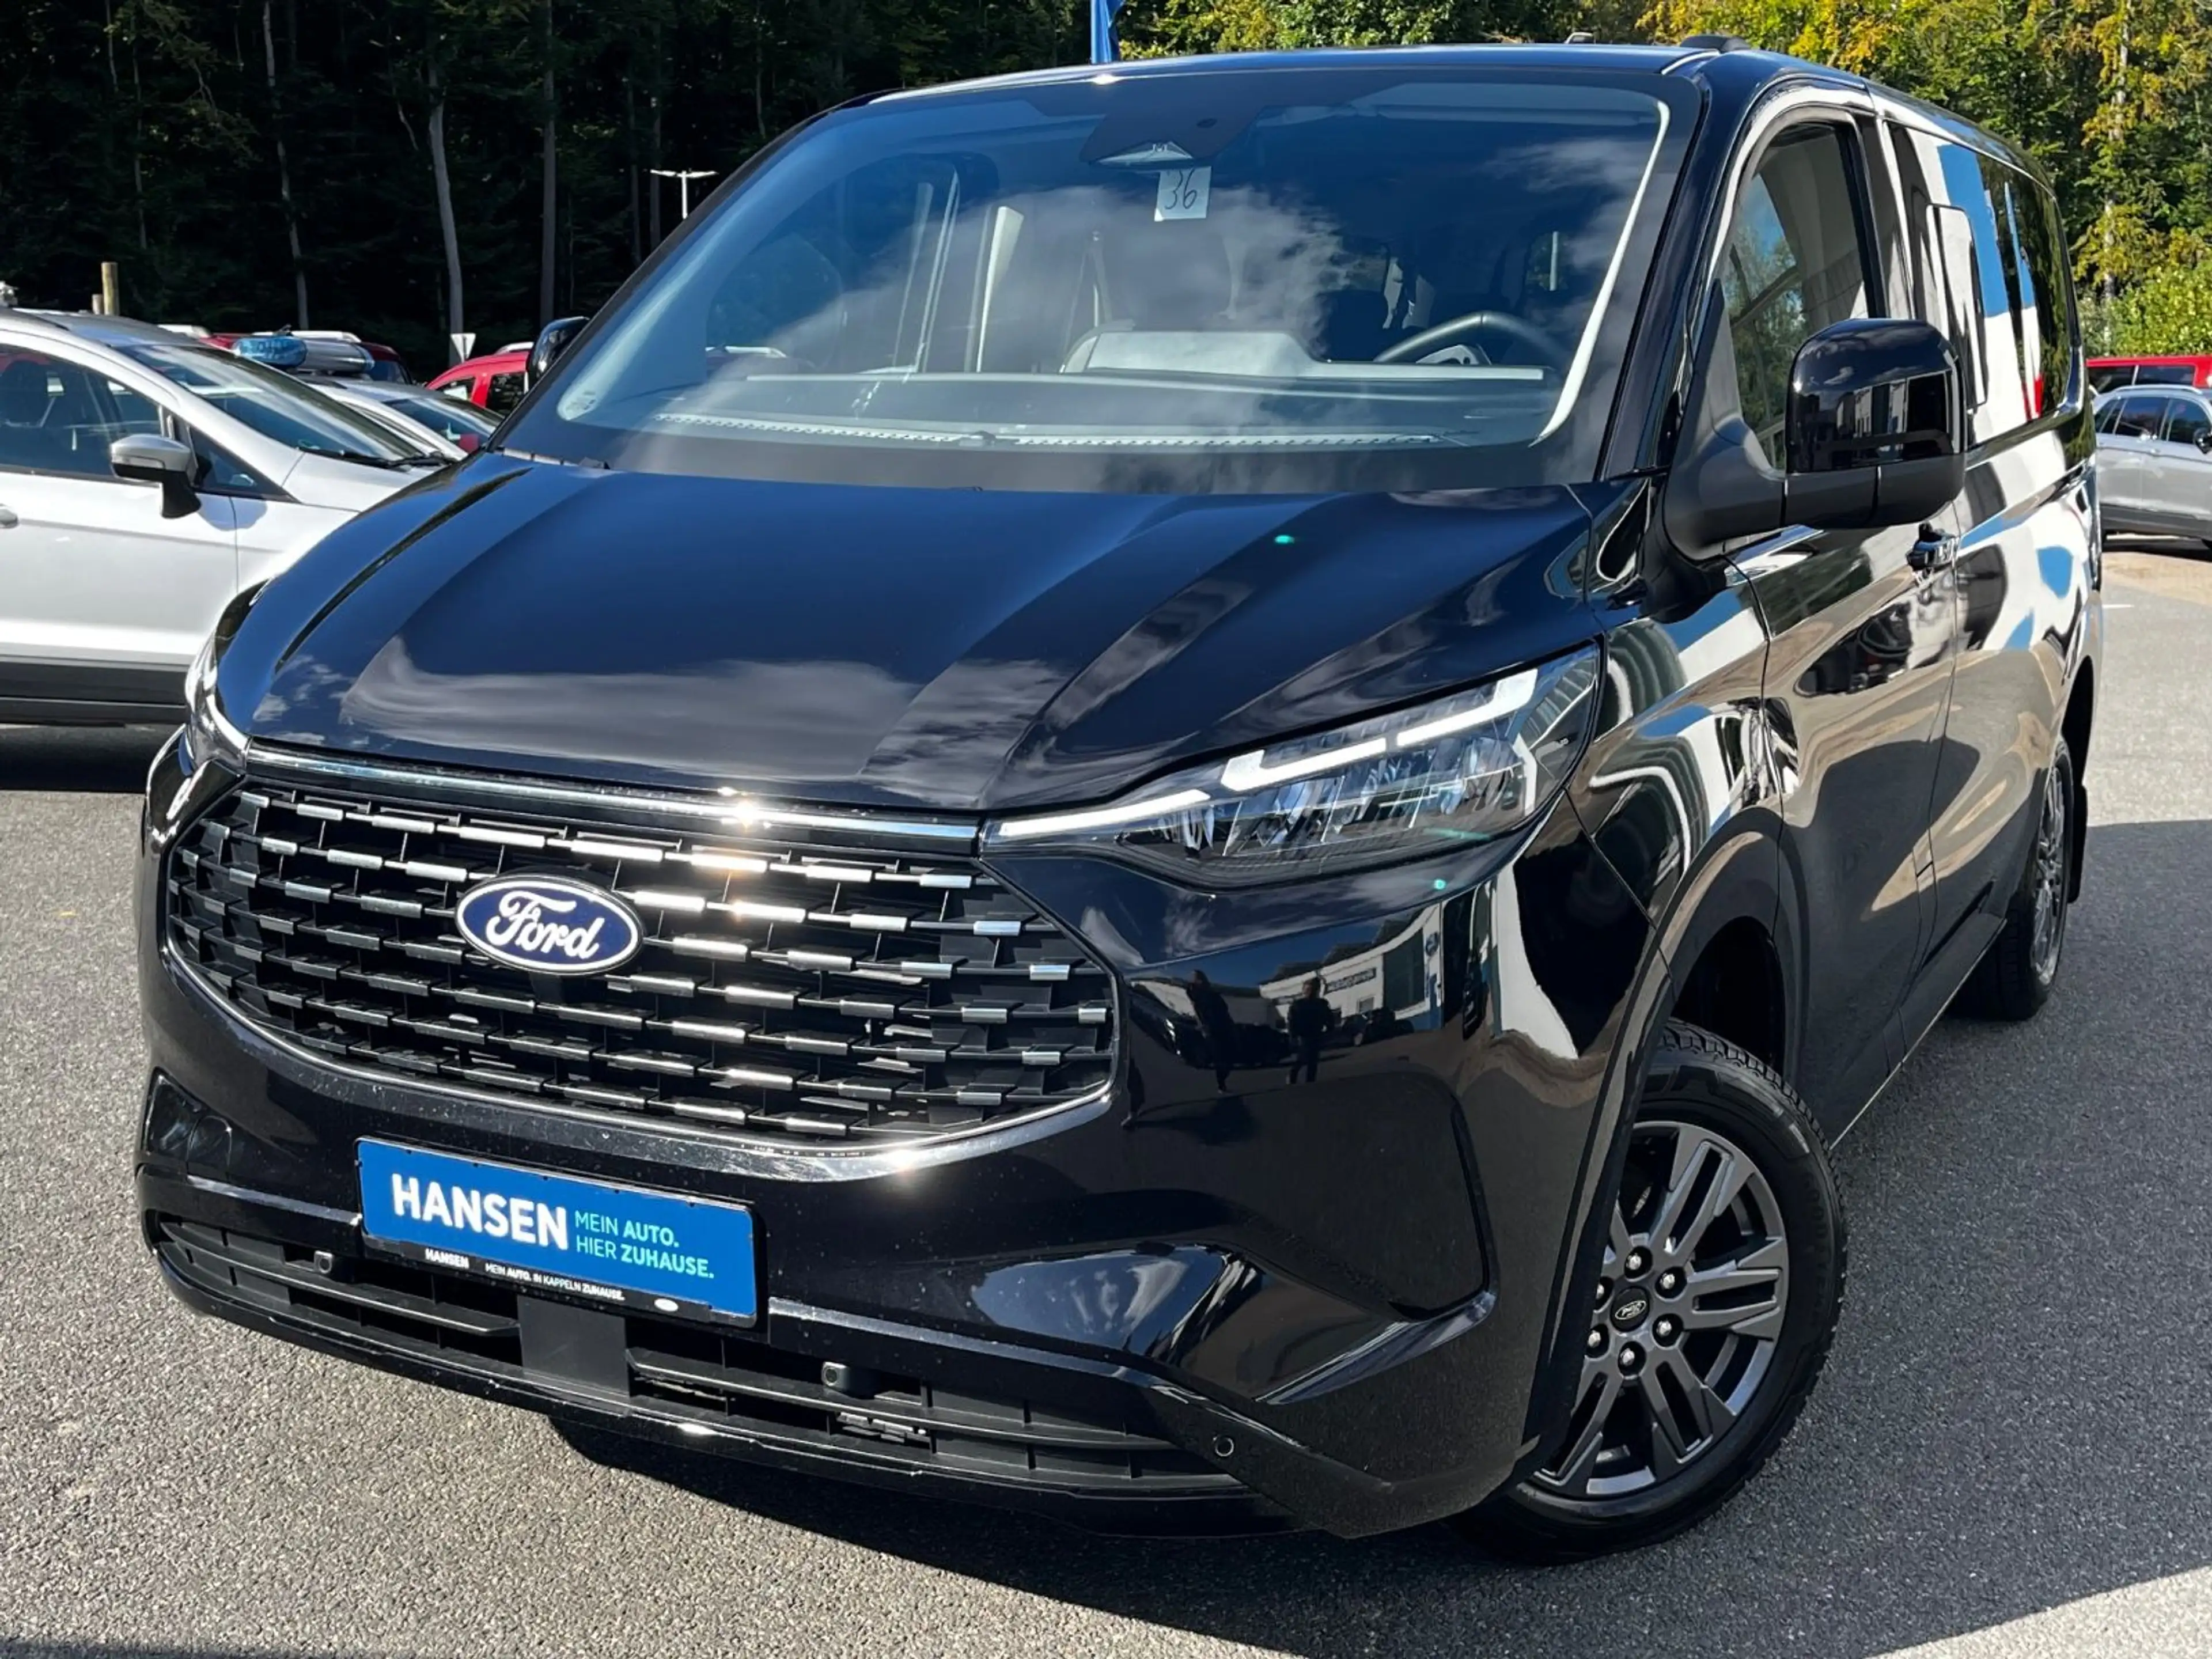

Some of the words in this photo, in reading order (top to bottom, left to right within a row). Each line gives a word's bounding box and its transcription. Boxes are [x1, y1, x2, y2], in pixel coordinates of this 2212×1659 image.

[1164, 168, 1197, 209] 36
[486, 891, 605, 959] Ford
[392, 1173, 568, 1251] HANSEN
[575, 1210, 619, 1236] MEIN
[623, 1220, 680, 1248] AUTO.
[425, 1248, 469, 1269] HANSEN
[485, 1263, 505, 1275] MEIN
[544, 1275, 581, 1291] KAPPELN
[577, 1235, 617, 1260] HIER
[620, 1243, 714, 1279] ZUHAUSE.
